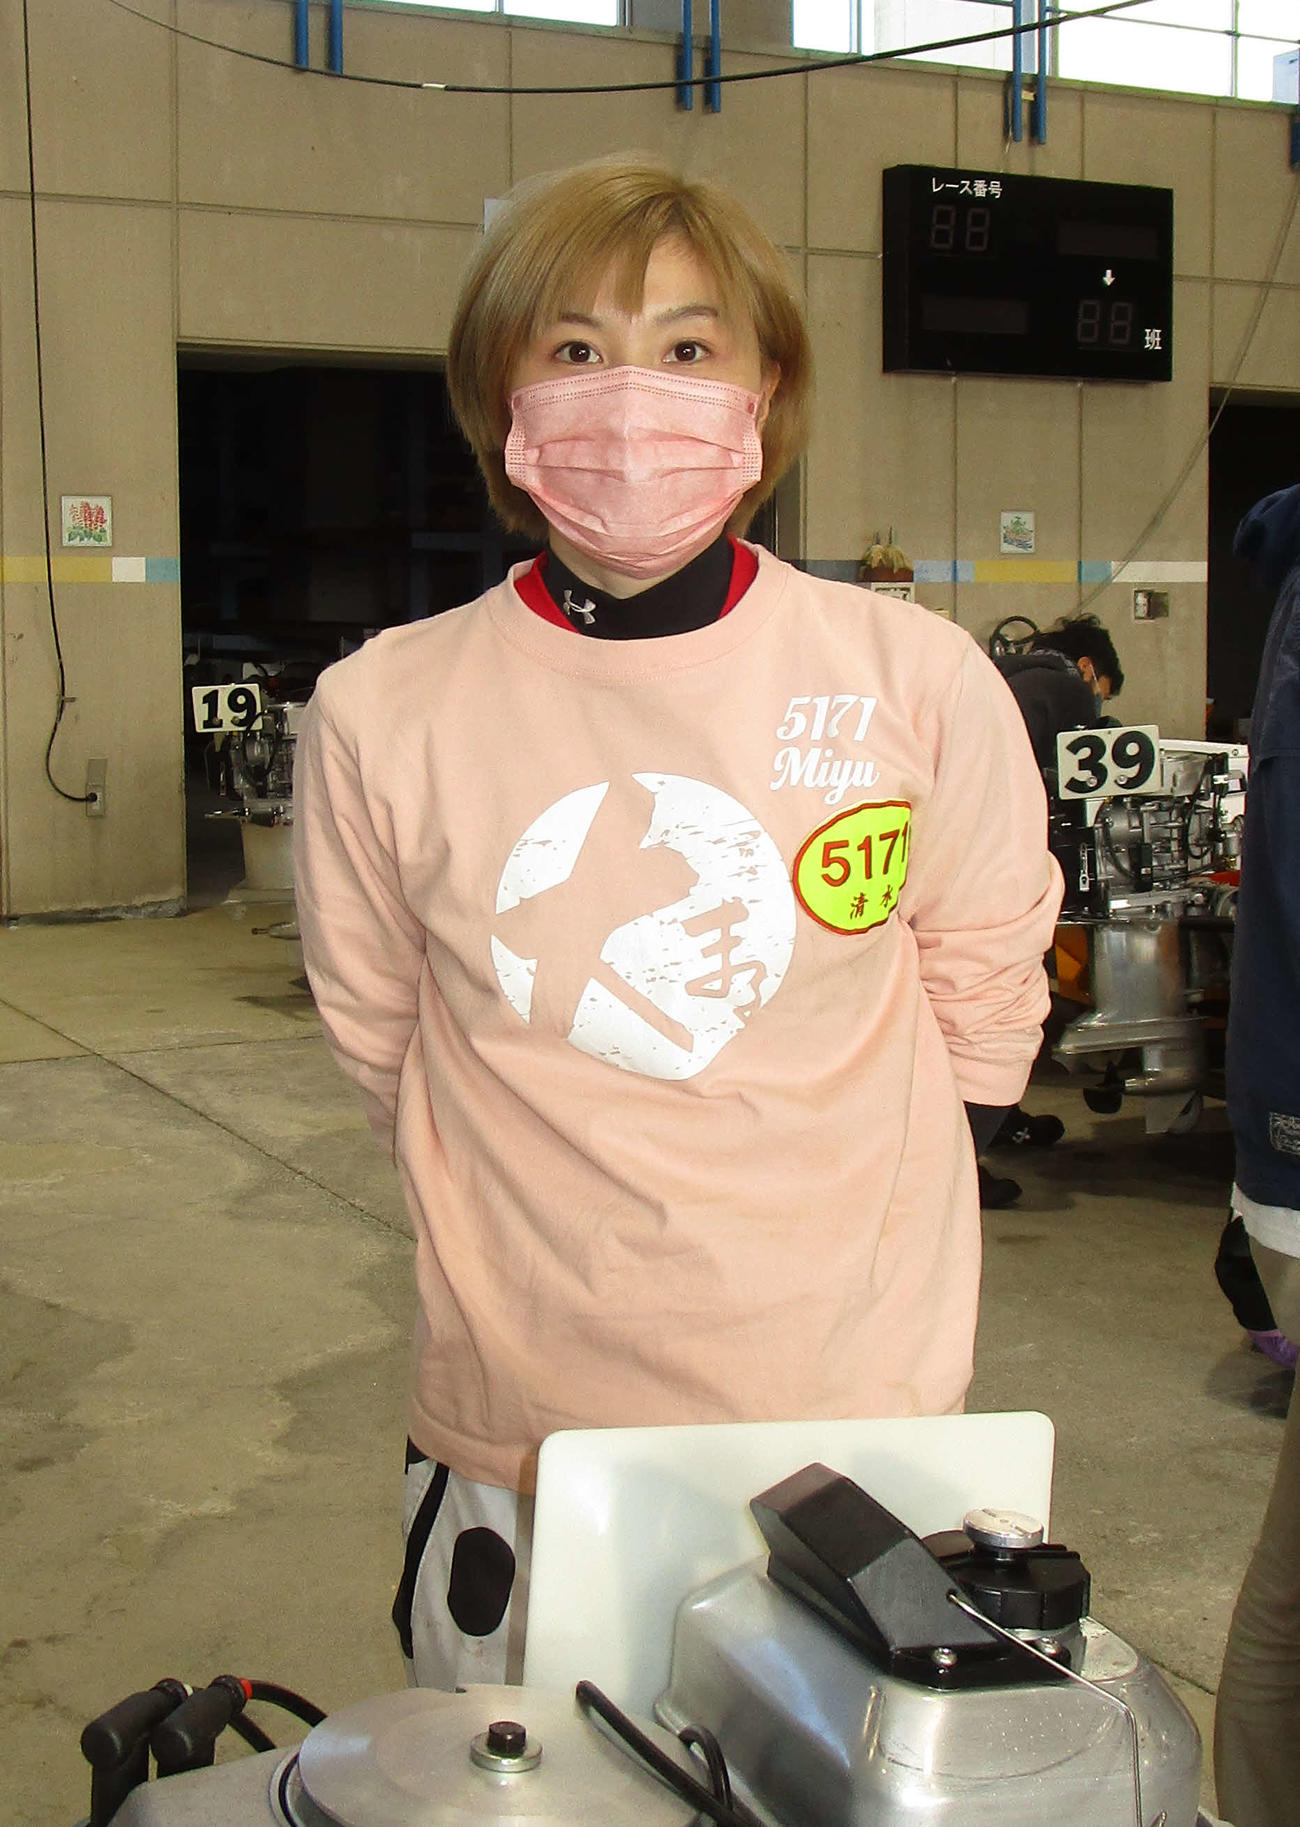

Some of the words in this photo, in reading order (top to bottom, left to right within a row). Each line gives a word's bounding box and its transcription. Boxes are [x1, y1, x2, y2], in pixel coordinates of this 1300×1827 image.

[931, 177, 1003, 199] レース番号
[1144, 328, 1162, 350] 班
[202, 687, 257, 729] 19
[776, 694, 878, 742] 5171
[770, 746, 880, 805] Miyu
[1064, 730, 1156, 794] 39
[821, 821, 911, 887] 5171
